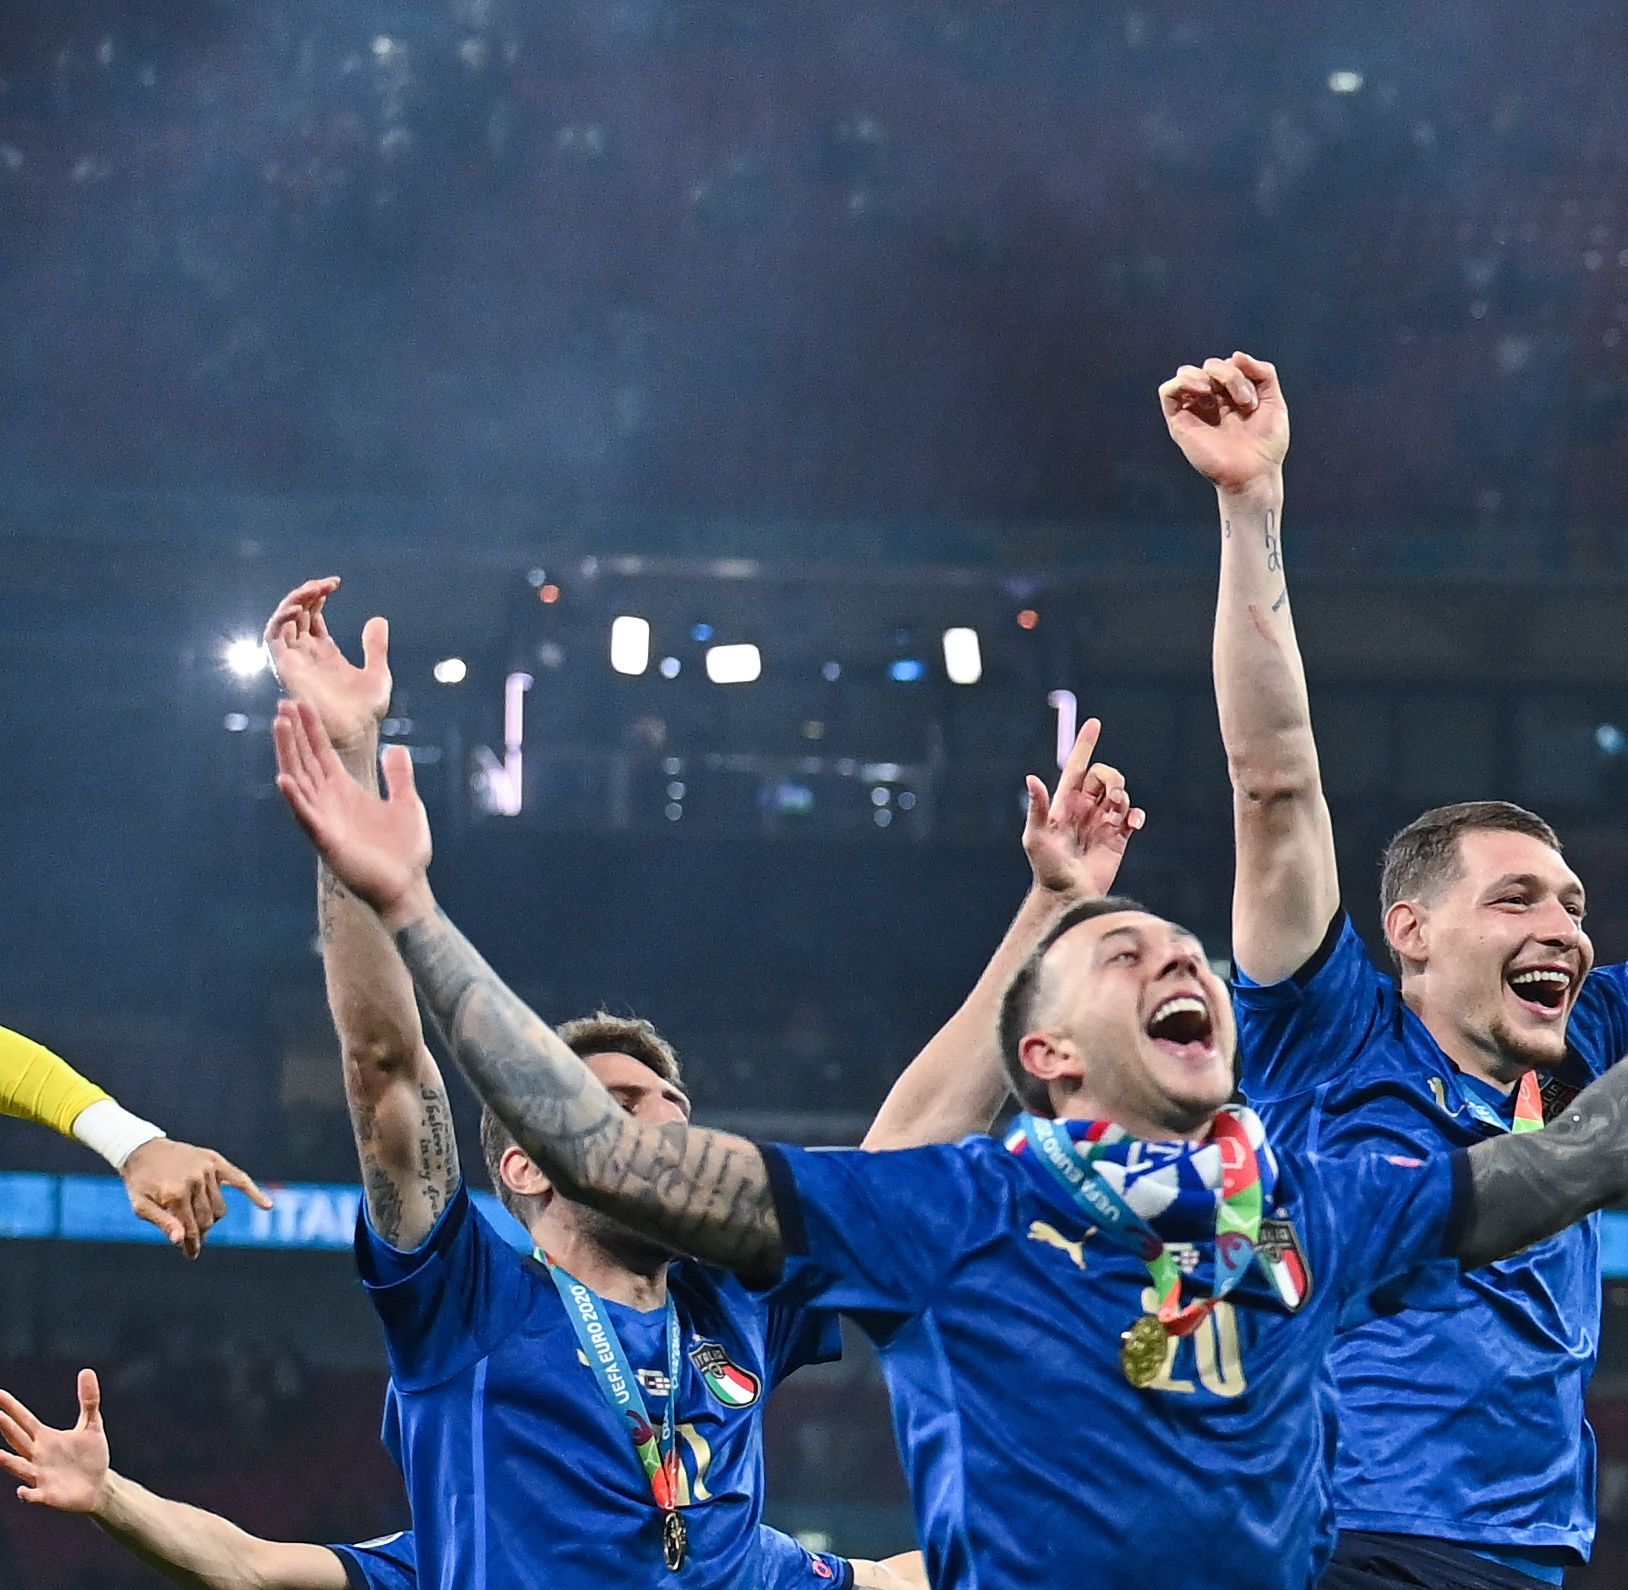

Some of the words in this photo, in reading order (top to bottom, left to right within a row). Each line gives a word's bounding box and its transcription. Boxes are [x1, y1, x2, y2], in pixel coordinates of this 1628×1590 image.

[252, 1188, 357, 1244] ITAL
[571, 1285, 596, 1322] 2020
[587, 1322, 615, 1364] EURO
[606, 1361, 631, 1404] UEFA
